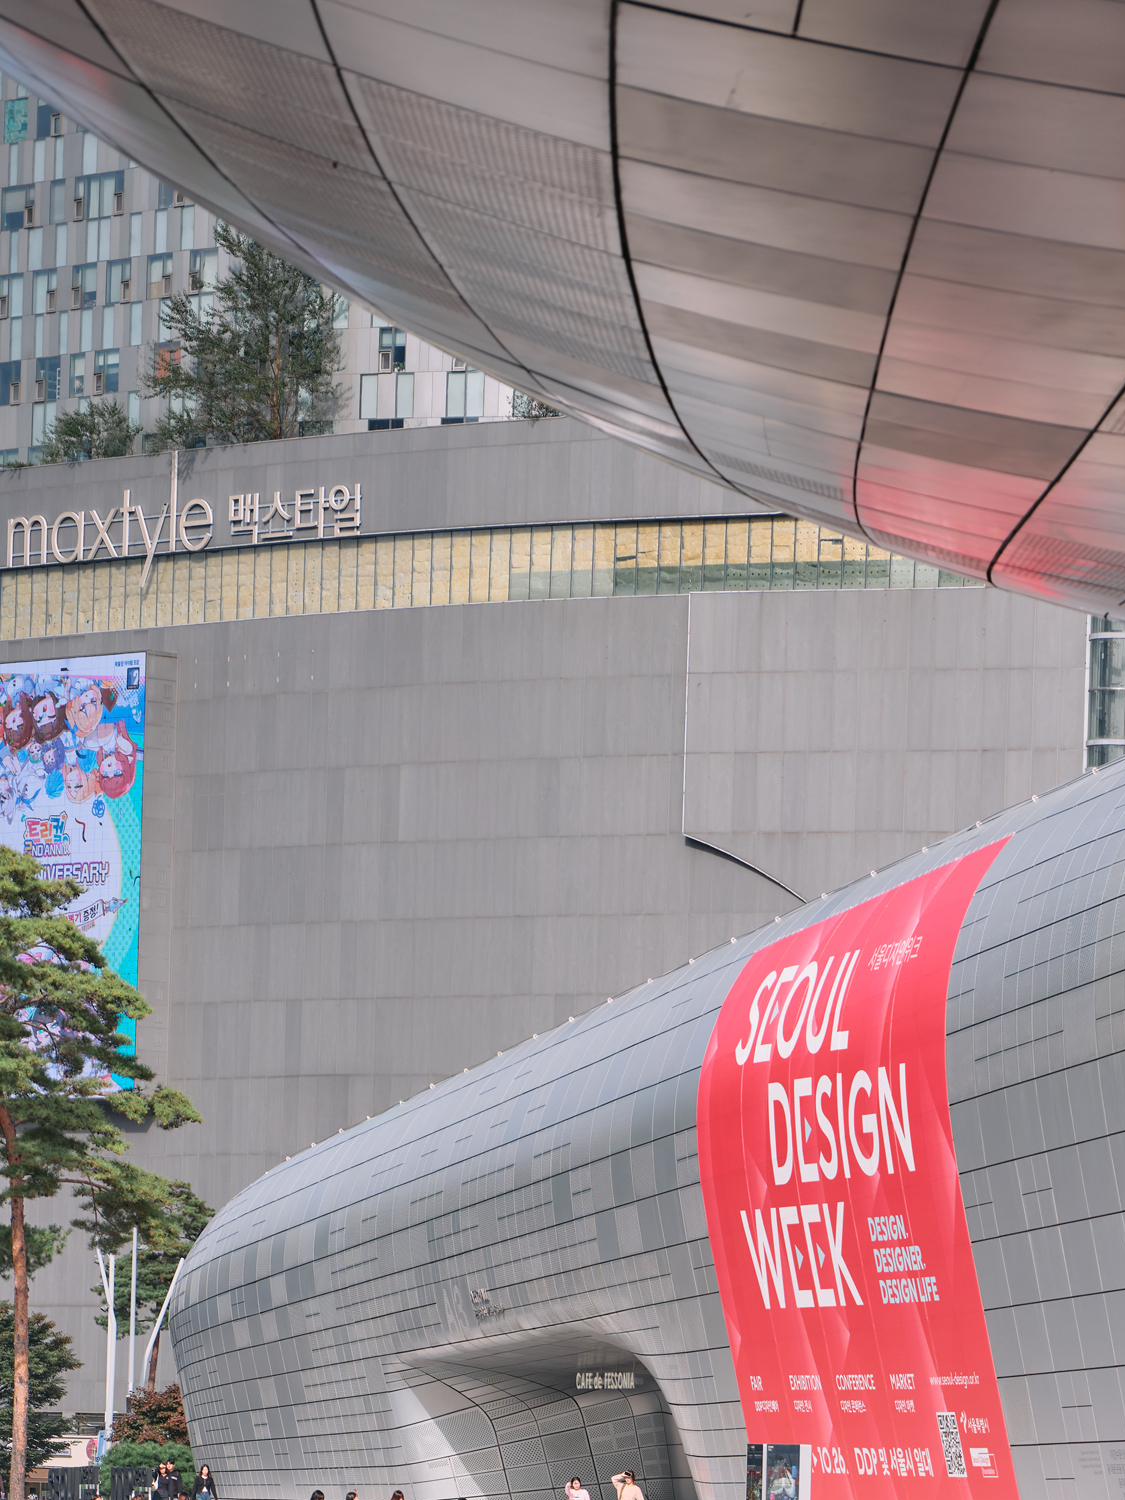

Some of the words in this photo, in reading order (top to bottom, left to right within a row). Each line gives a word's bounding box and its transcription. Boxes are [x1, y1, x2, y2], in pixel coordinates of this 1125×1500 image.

[5, 451, 214, 588] maxtyle
[228, 482, 362, 544] 맥스타일
[867, 936, 923, 971] 서울디자인위크
[735, 949, 861, 1066] SEOUL
[767, 1063, 916, 1186] DESIGN
[740, 1201, 864, 1310] WEEK
[878, 1278, 919, 1304] DESIGN
[916, 1276, 940, 1303] LIFE
[576, 1372, 592, 1389] CAFE
[593, 1373, 603, 1389] de
[750, 1375, 763, 1391] FAIR
[788, 1375, 822, 1390] EXHIBITION
[835, 1374, 876, 1390] CONFERENCE
[889, 1373, 916, 1390] MARKET
[967, 1417, 990, 1434] 서울특별시
[817, 1446, 849, 1475] 10.26.
[853, 1447, 877, 1475] DDP
[878, 1447, 890, 1476] 및
[889, 1447, 916, 1477] 서울시
[913, 1447, 934, 1477] 일대
